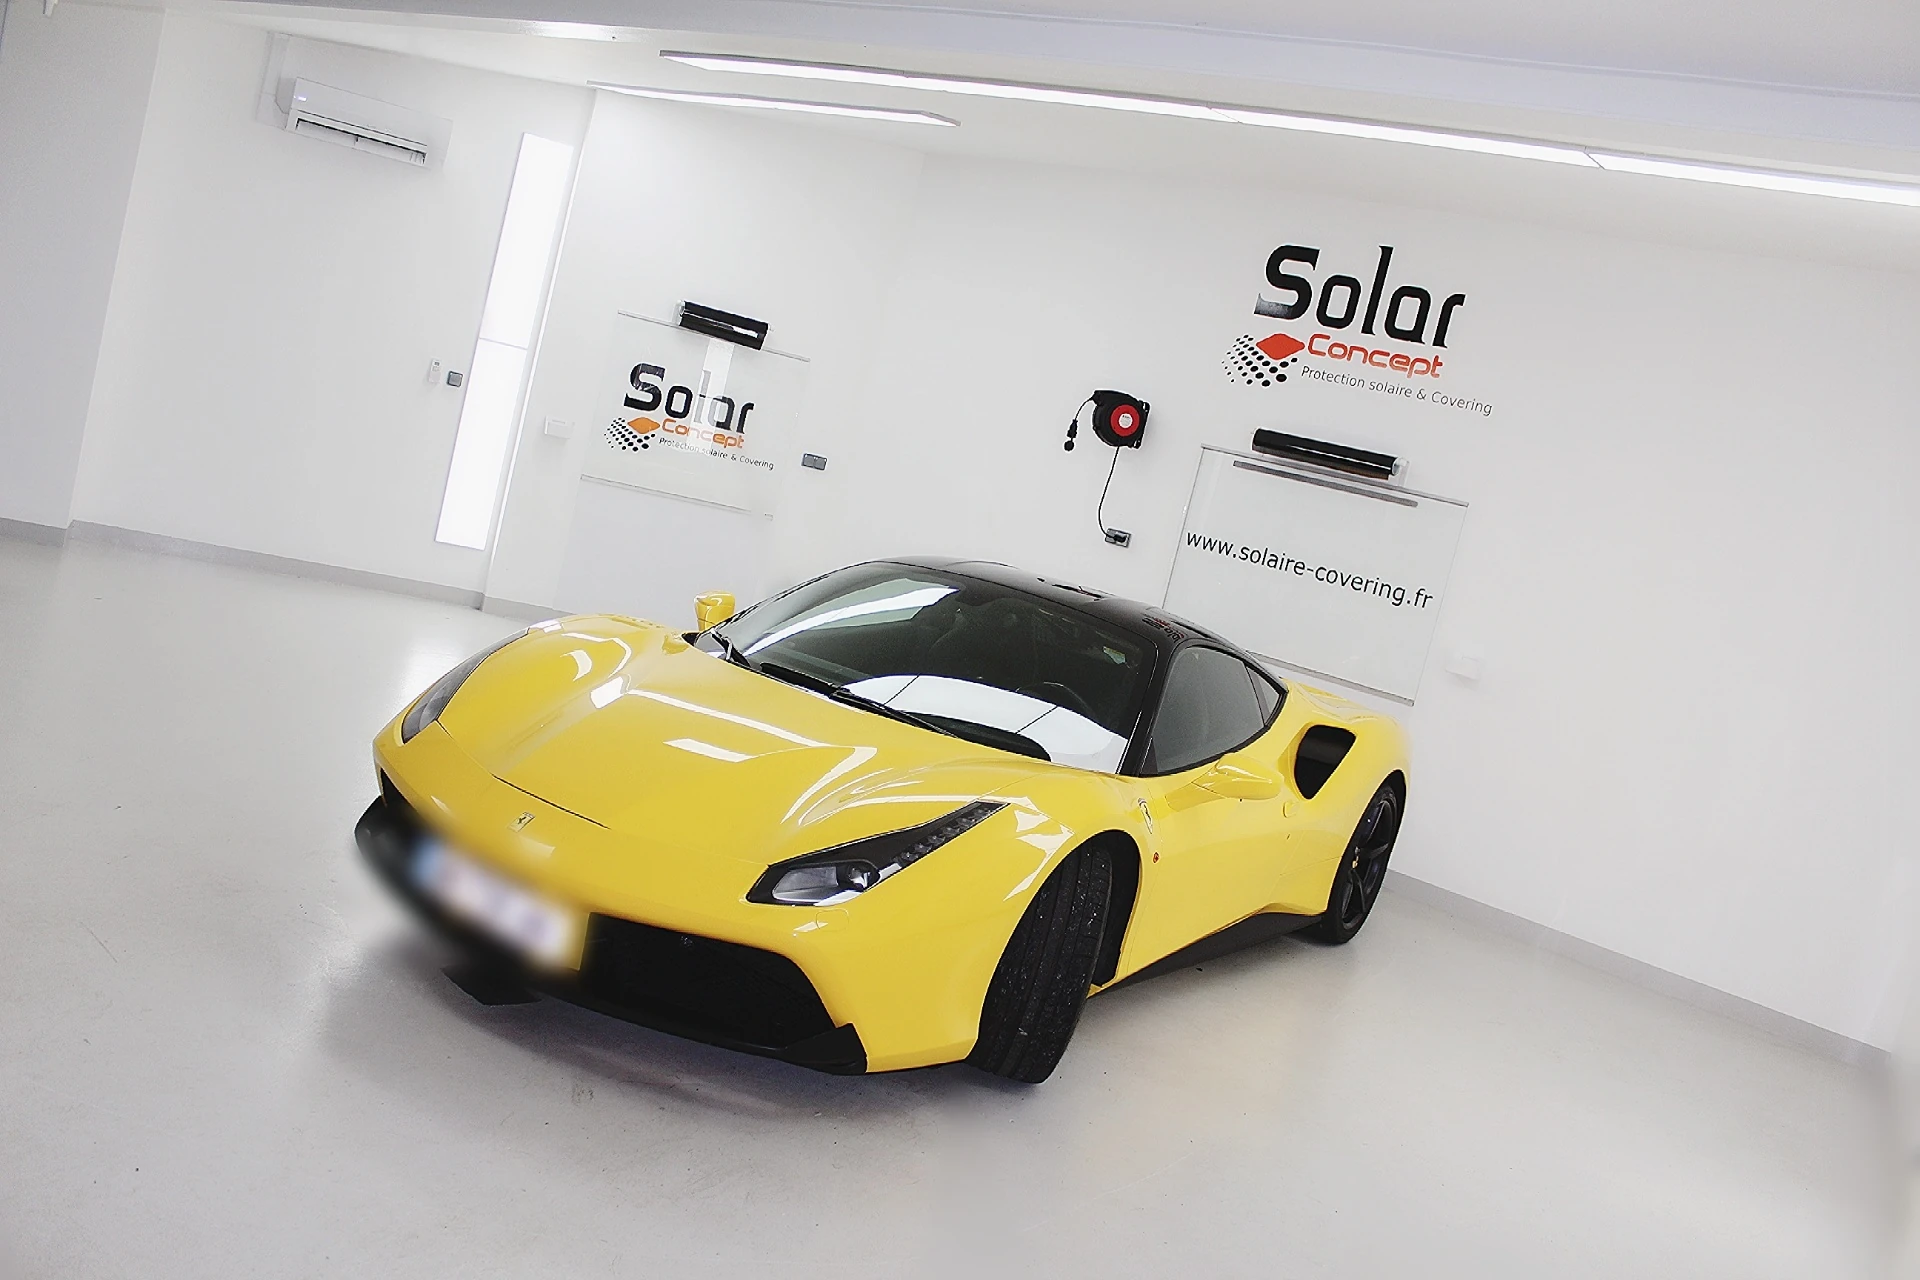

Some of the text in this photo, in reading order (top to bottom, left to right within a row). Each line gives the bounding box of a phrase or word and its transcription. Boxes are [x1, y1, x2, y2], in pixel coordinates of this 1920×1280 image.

[1254, 244, 1466, 348] Solar
[1308, 334, 1443, 378] Concept
[623, 362, 755, 435] Solar
[1300, 365, 1493, 417] Protection solaire & Covering
[659, 437, 775, 470] Protection solaire & Covering
[661, 417, 745, 448] Concept
[1186, 531, 1433, 609] www.solaire-covering.fr
